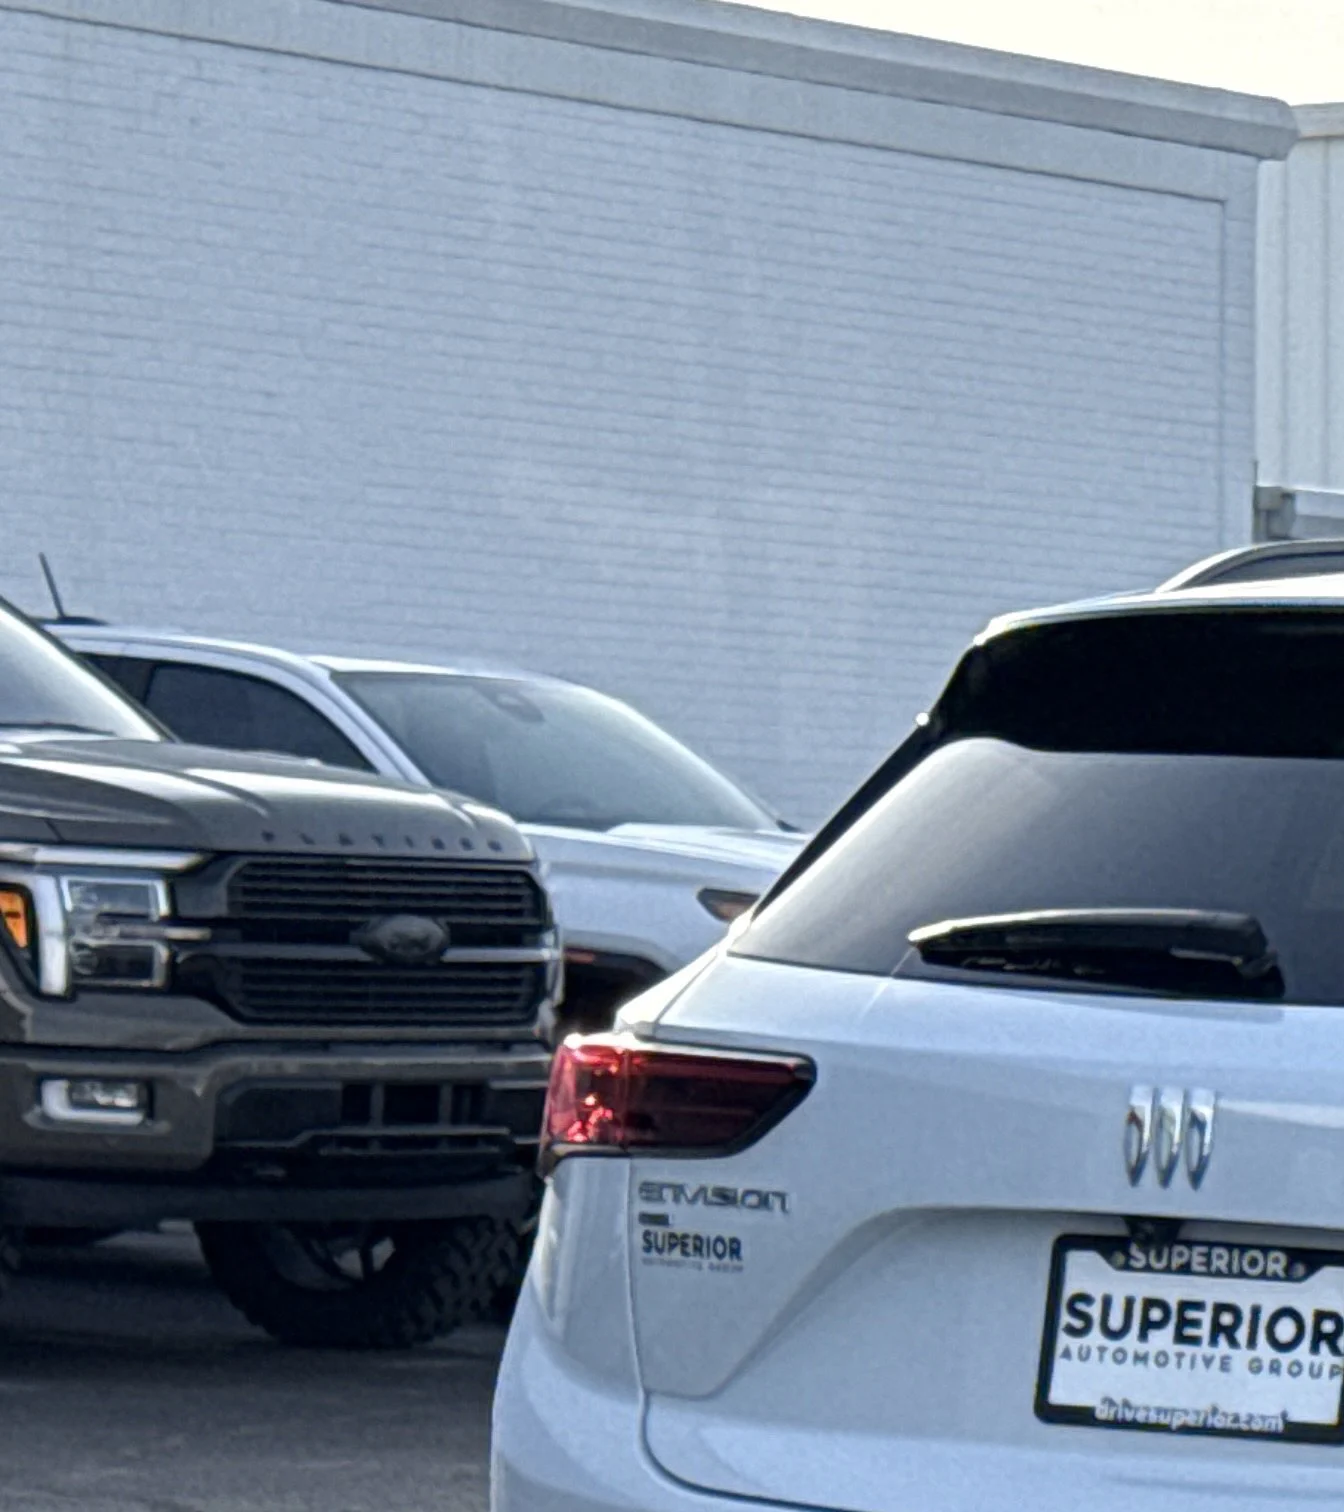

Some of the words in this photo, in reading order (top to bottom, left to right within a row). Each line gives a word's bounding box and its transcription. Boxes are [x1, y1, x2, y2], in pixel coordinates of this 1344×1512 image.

[641, 1229, 743, 1261] SUPERIOR
[1129, 1244, 1288, 1279] SUPERIOR
[1062, 1291, 1344, 1357] SUPERIOR
[1059, 1343, 1233, 1374] AUTOMOTIVE
[1248, 1356, 1344, 1381] GROUP
